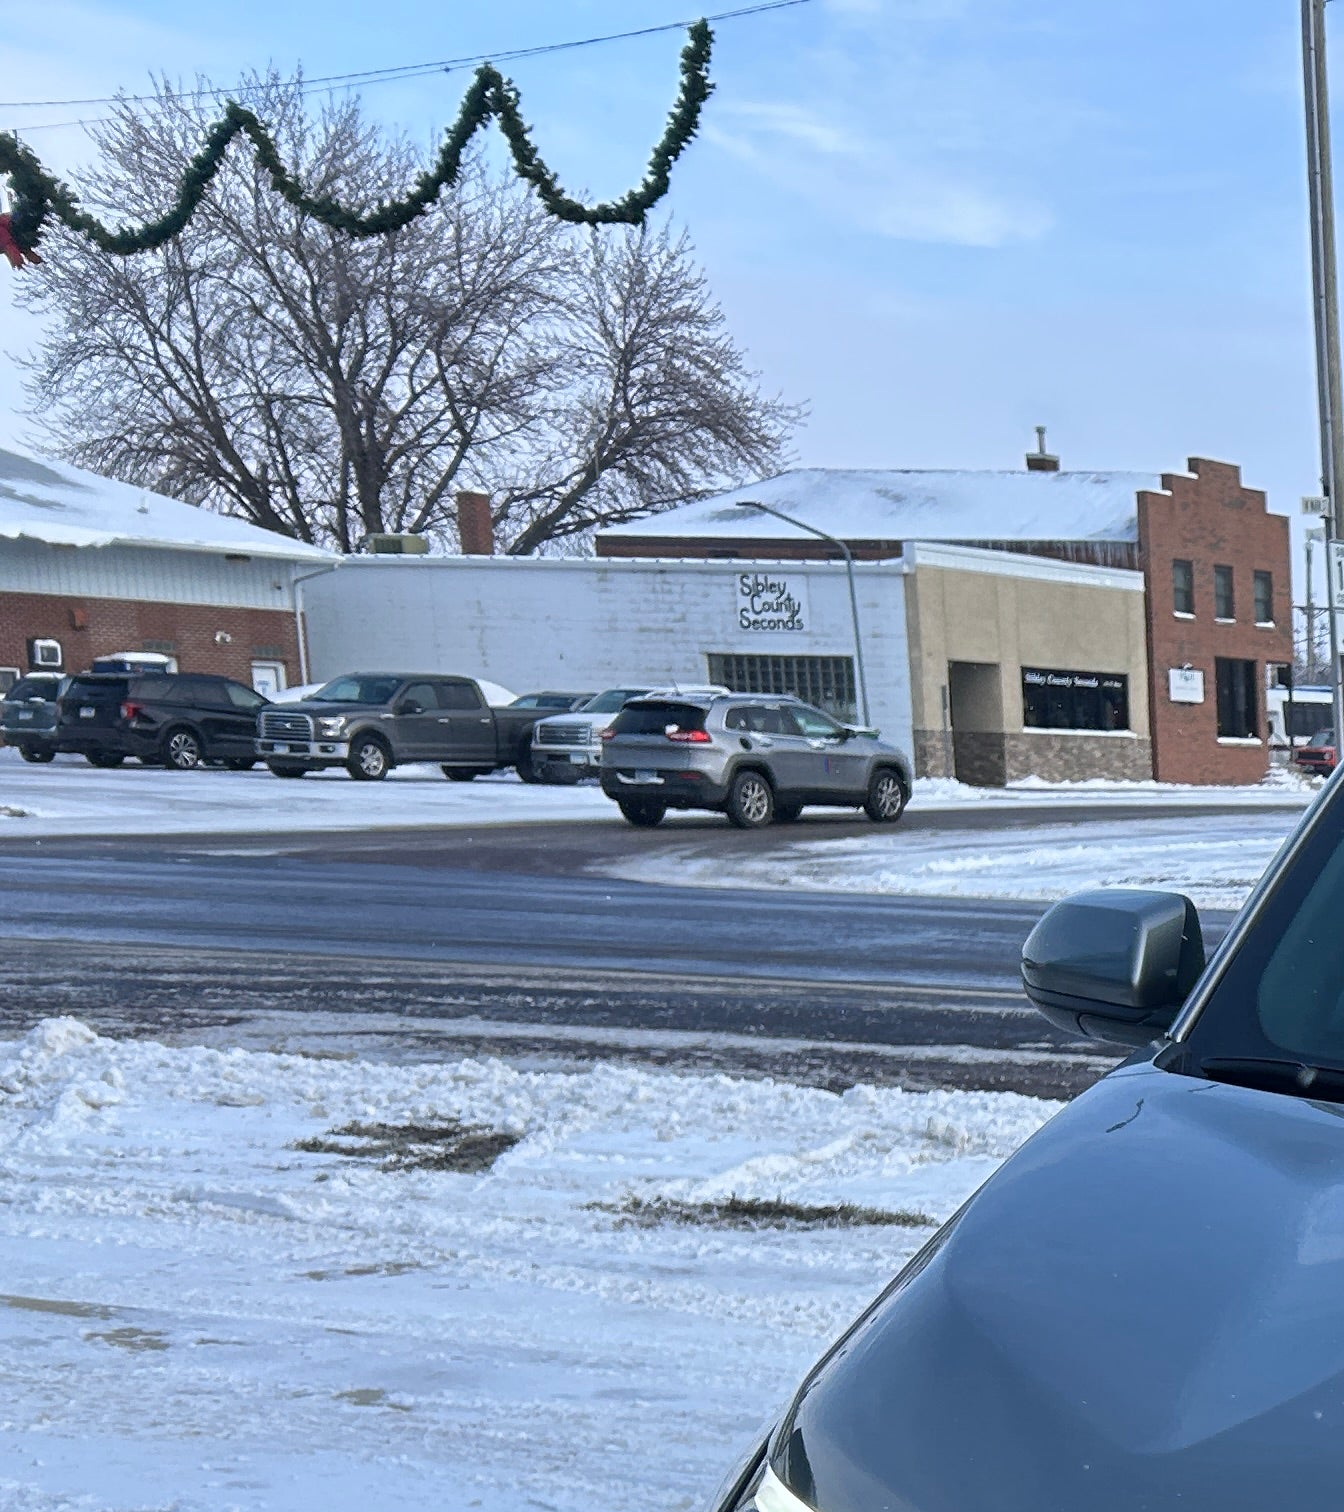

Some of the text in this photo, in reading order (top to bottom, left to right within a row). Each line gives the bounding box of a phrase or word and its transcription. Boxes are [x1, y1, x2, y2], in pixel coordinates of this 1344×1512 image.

[740, 574, 787, 601] Sibley
[750, 592, 801, 618] County
[740, 607, 804, 631] Seconds
